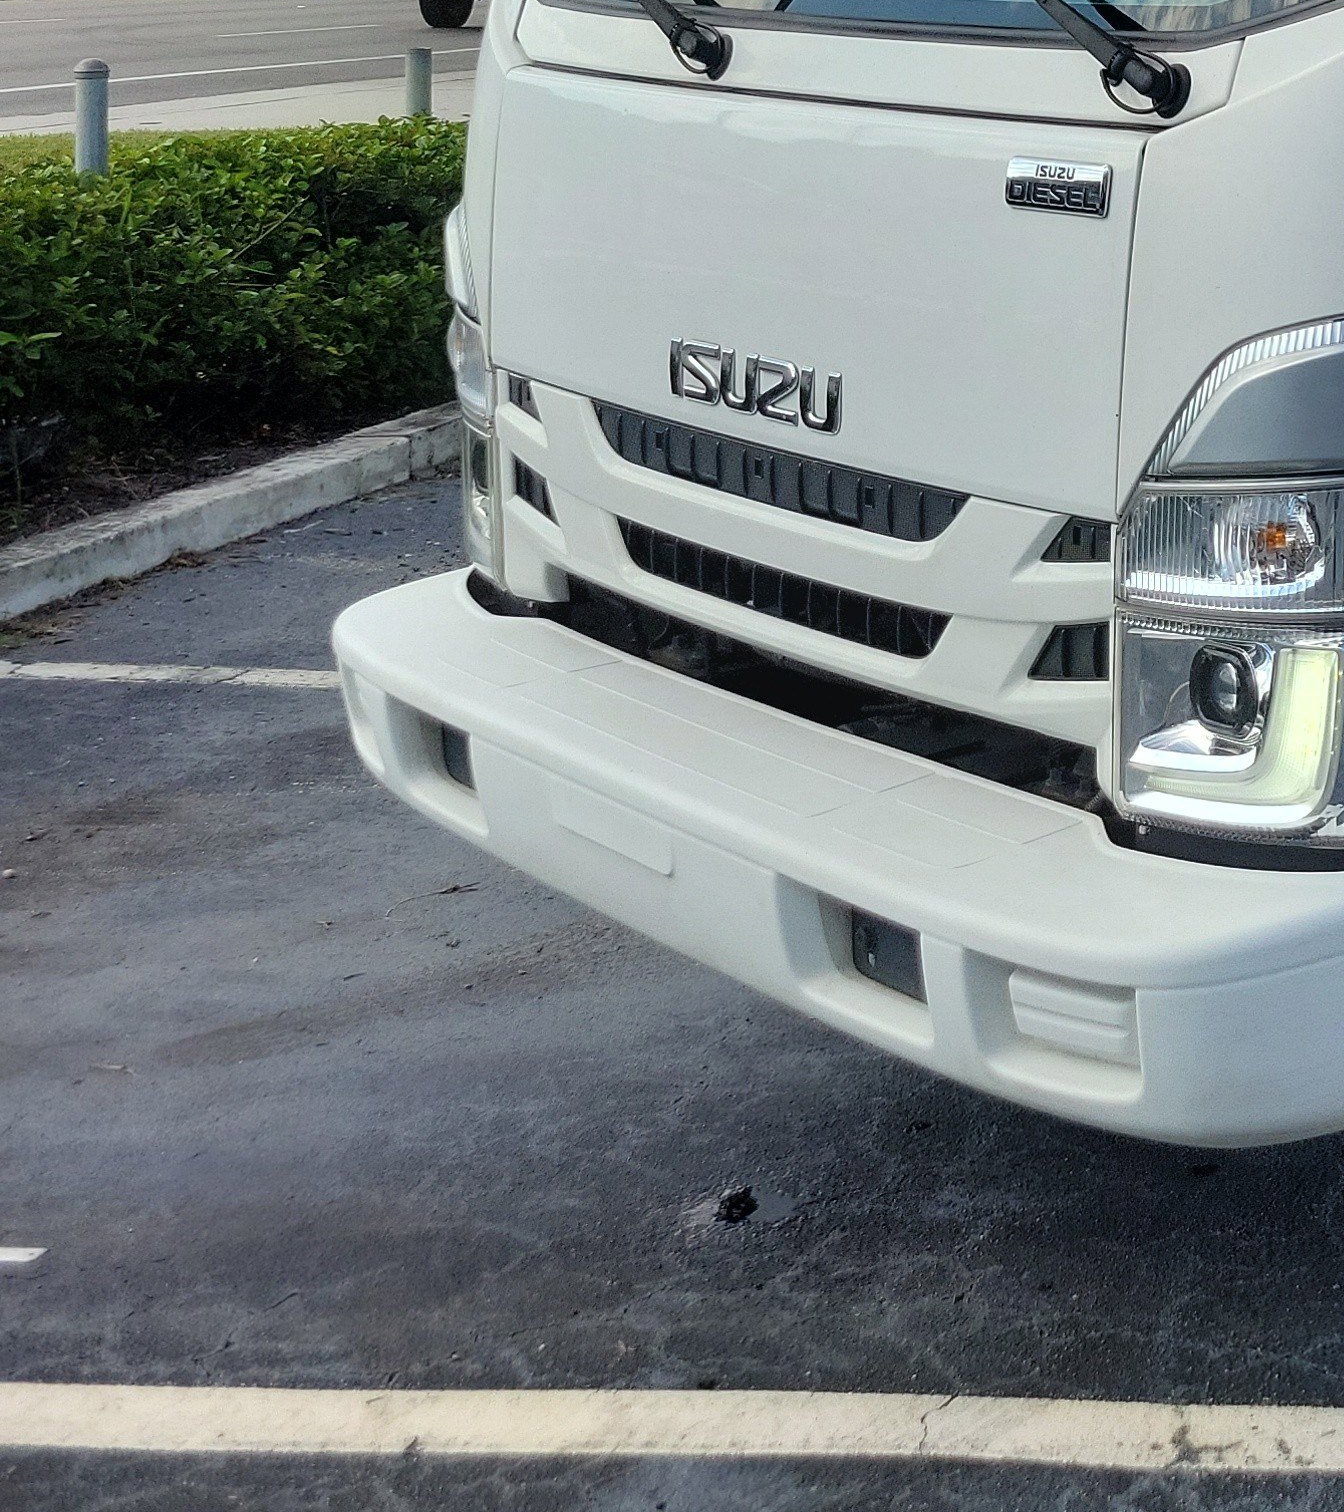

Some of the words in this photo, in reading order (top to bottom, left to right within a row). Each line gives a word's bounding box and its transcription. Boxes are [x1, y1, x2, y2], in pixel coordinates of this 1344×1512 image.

[1035, 164, 1076, 180] ISUZU
[1007, 180, 1102, 212] DIESEL
[669, 337, 843, 435] ISUZU
